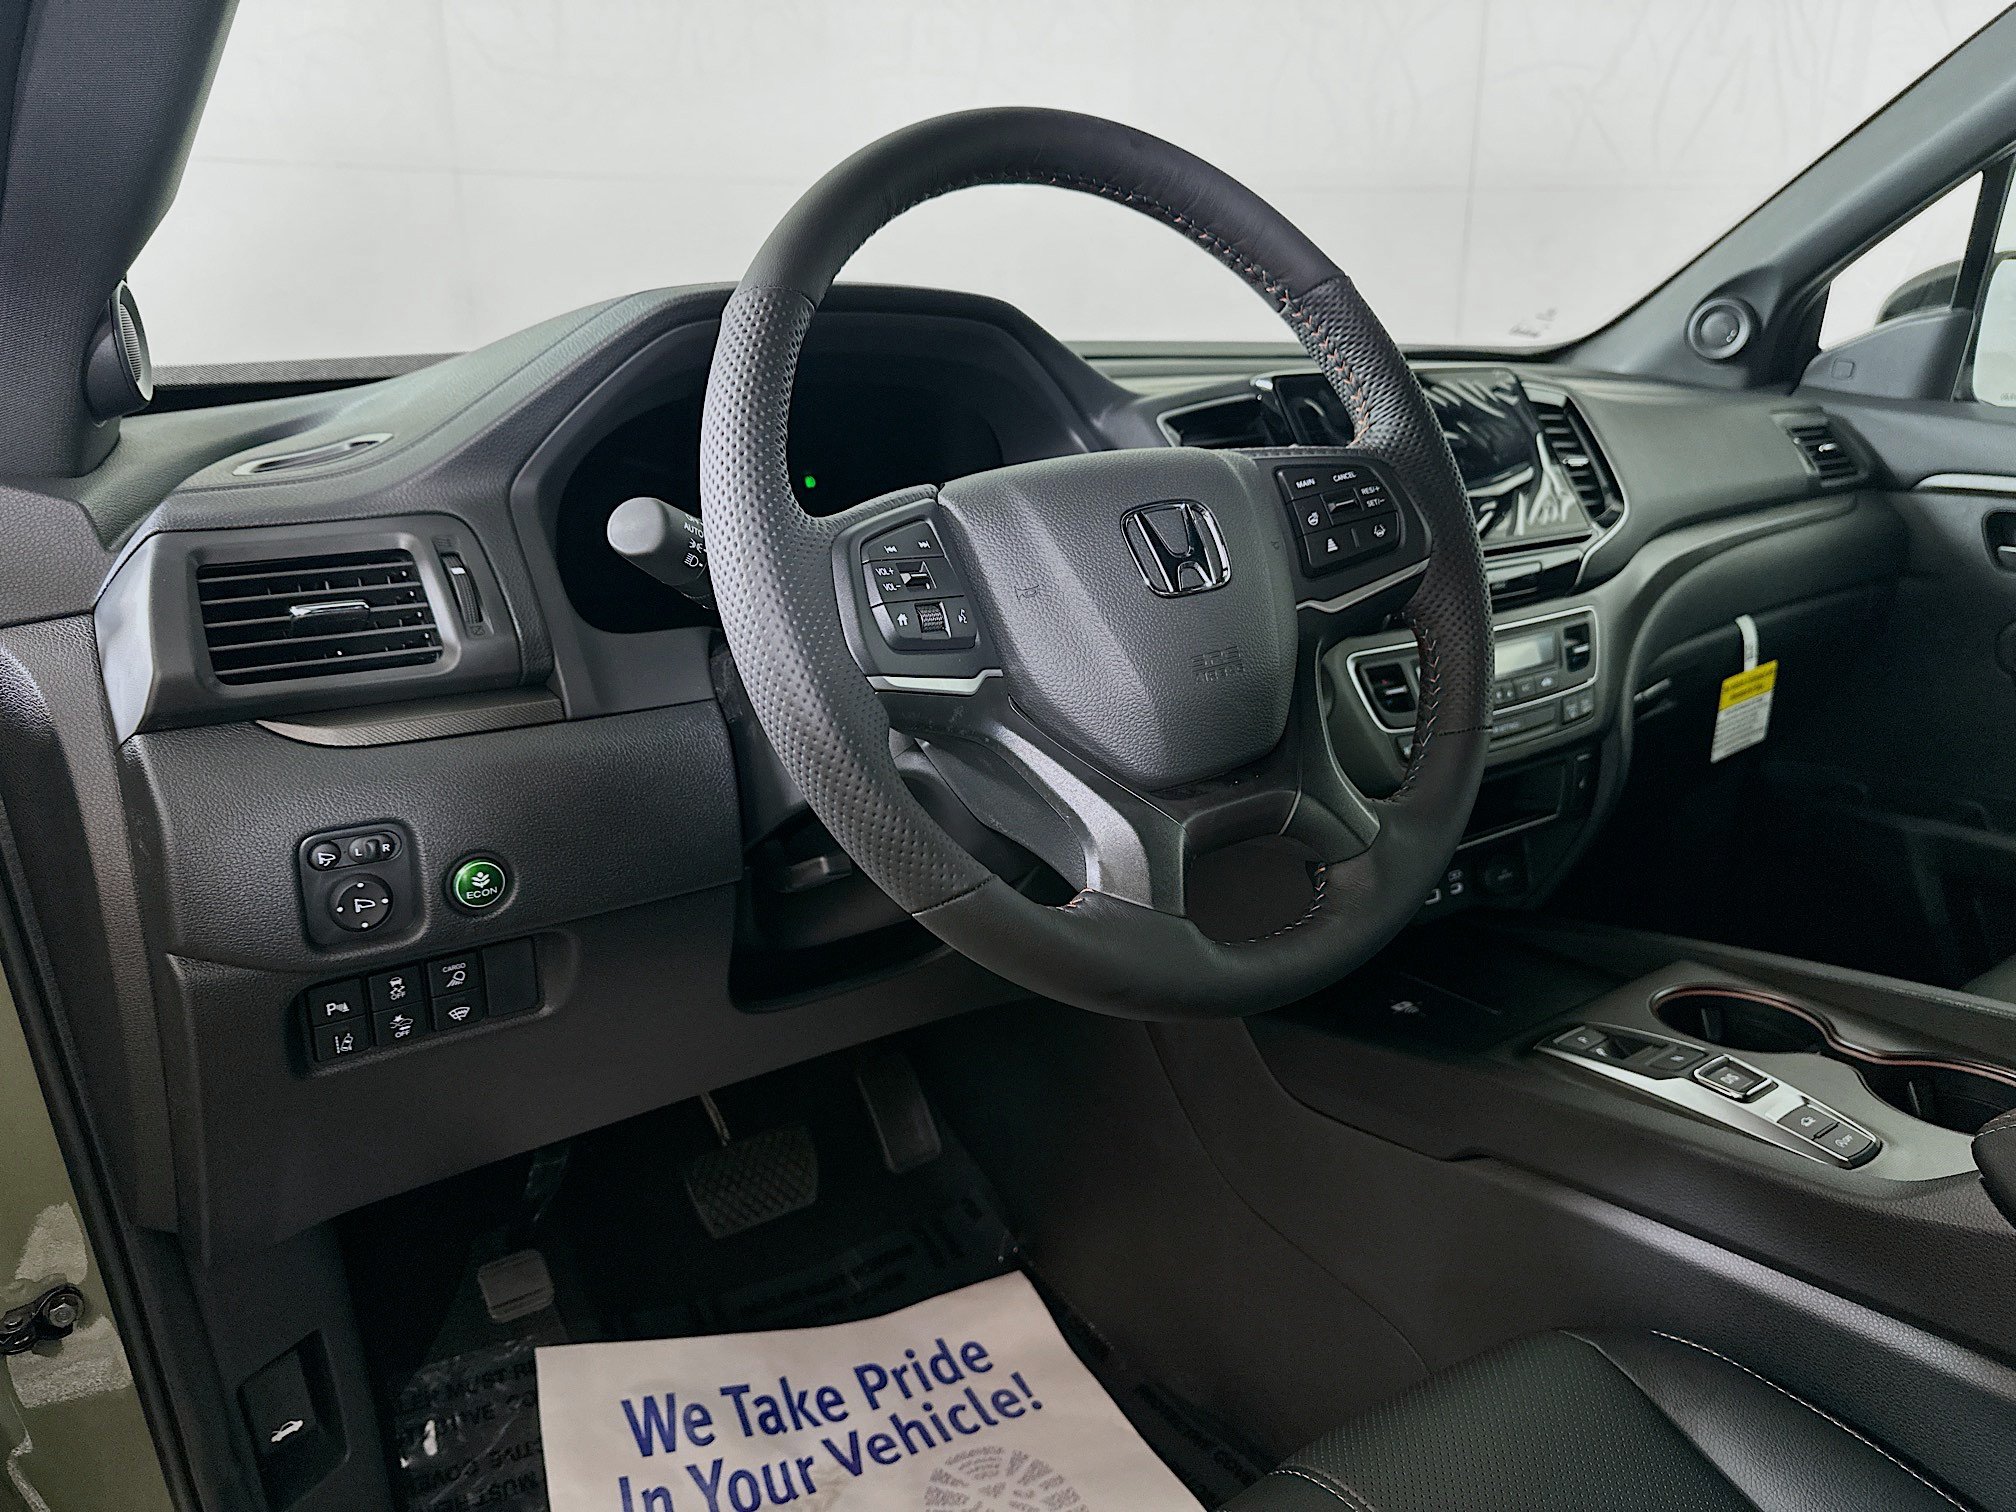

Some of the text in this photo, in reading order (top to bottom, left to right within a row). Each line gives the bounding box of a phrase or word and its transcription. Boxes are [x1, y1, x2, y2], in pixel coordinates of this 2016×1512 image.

[1332, 471, 1357, 482] CANCEL
[1295, 478, 1316, 489] MAIN
[683, 521, 704, 539] AUTO
[354, 843, 391, 857] L R
[466, 886, 498, 900] ECON
[442, 962, 467, 973] CARGO
[390, 990, 406, 1001] OFF
[394, 1029, 411, 1039] OFF
[620, 1339, 993, 1457] We Take Pride
[618, 1372, 1043, 1512] In Your Vehicle!
